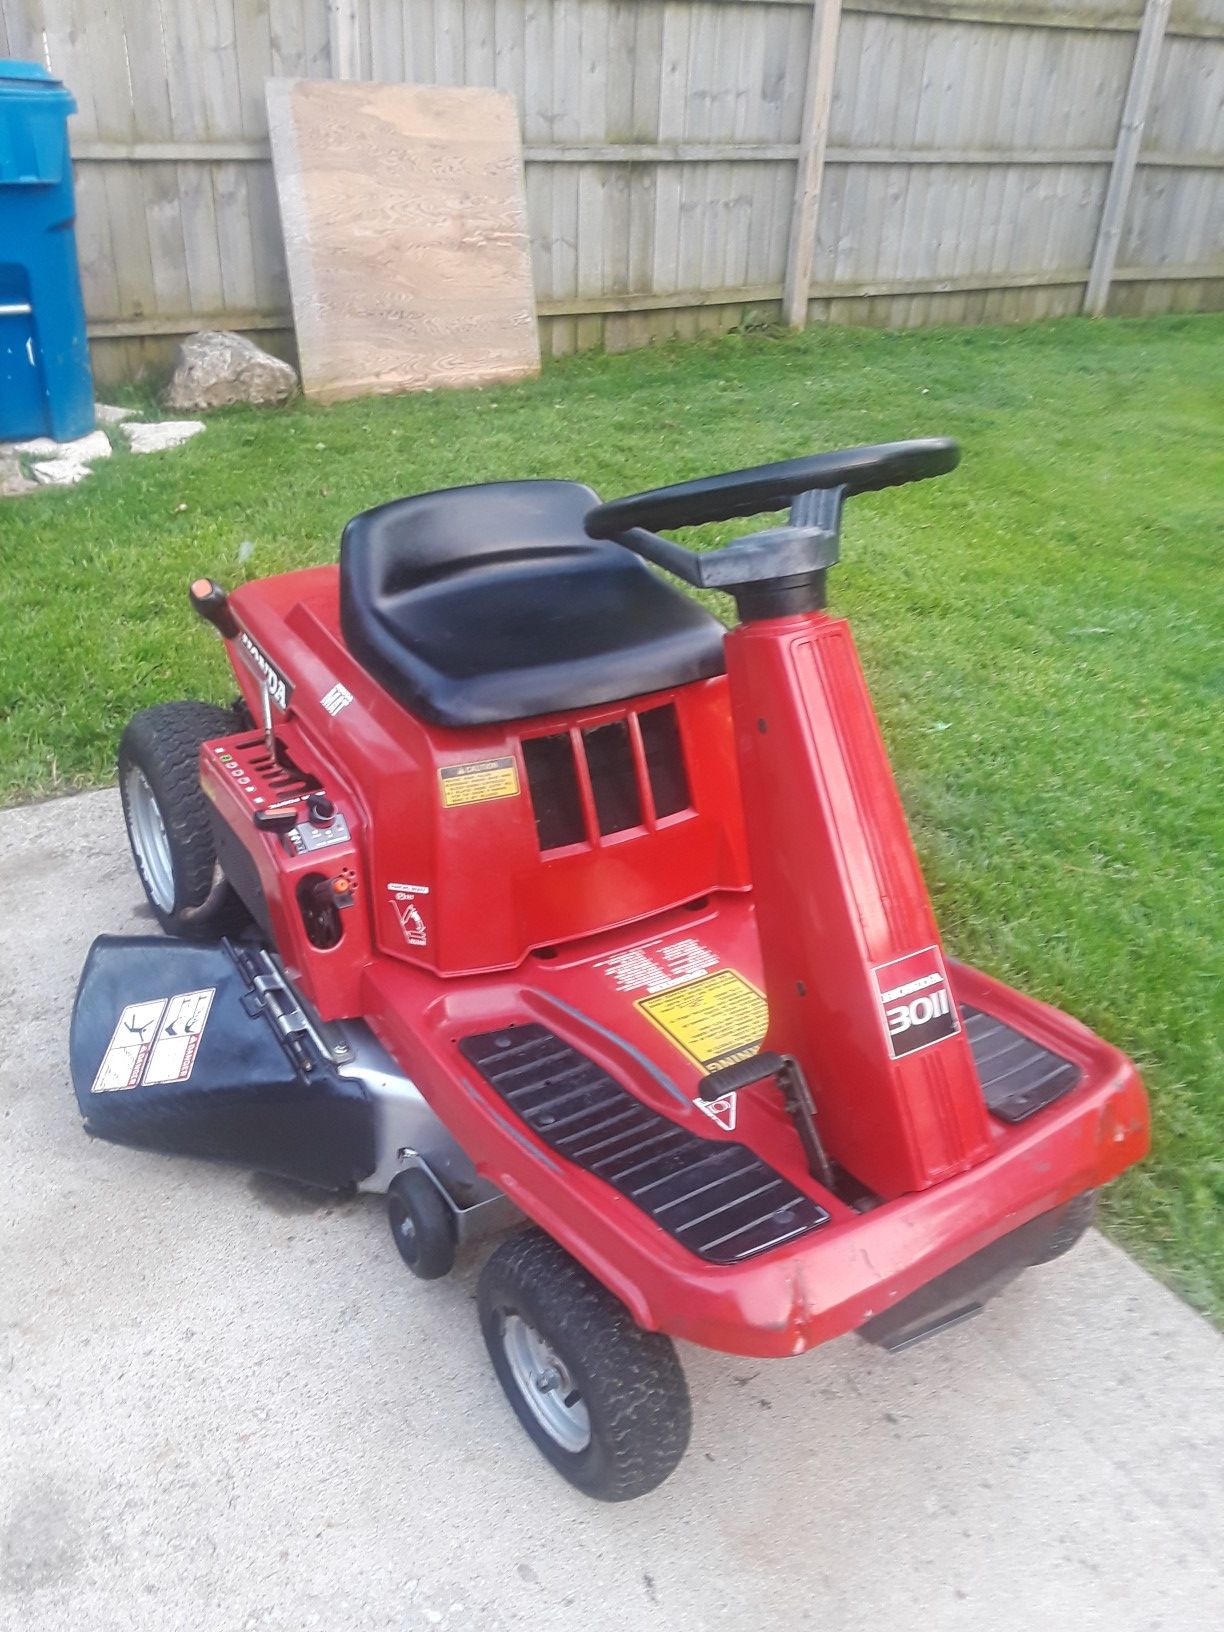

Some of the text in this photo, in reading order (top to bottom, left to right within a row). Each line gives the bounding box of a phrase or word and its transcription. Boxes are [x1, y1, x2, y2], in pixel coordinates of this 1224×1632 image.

[887, 990, 949, 1035] 3011
[129, 1051, 147, 1086] DANGER
[179, 1044, 196, 1077] DANGER
